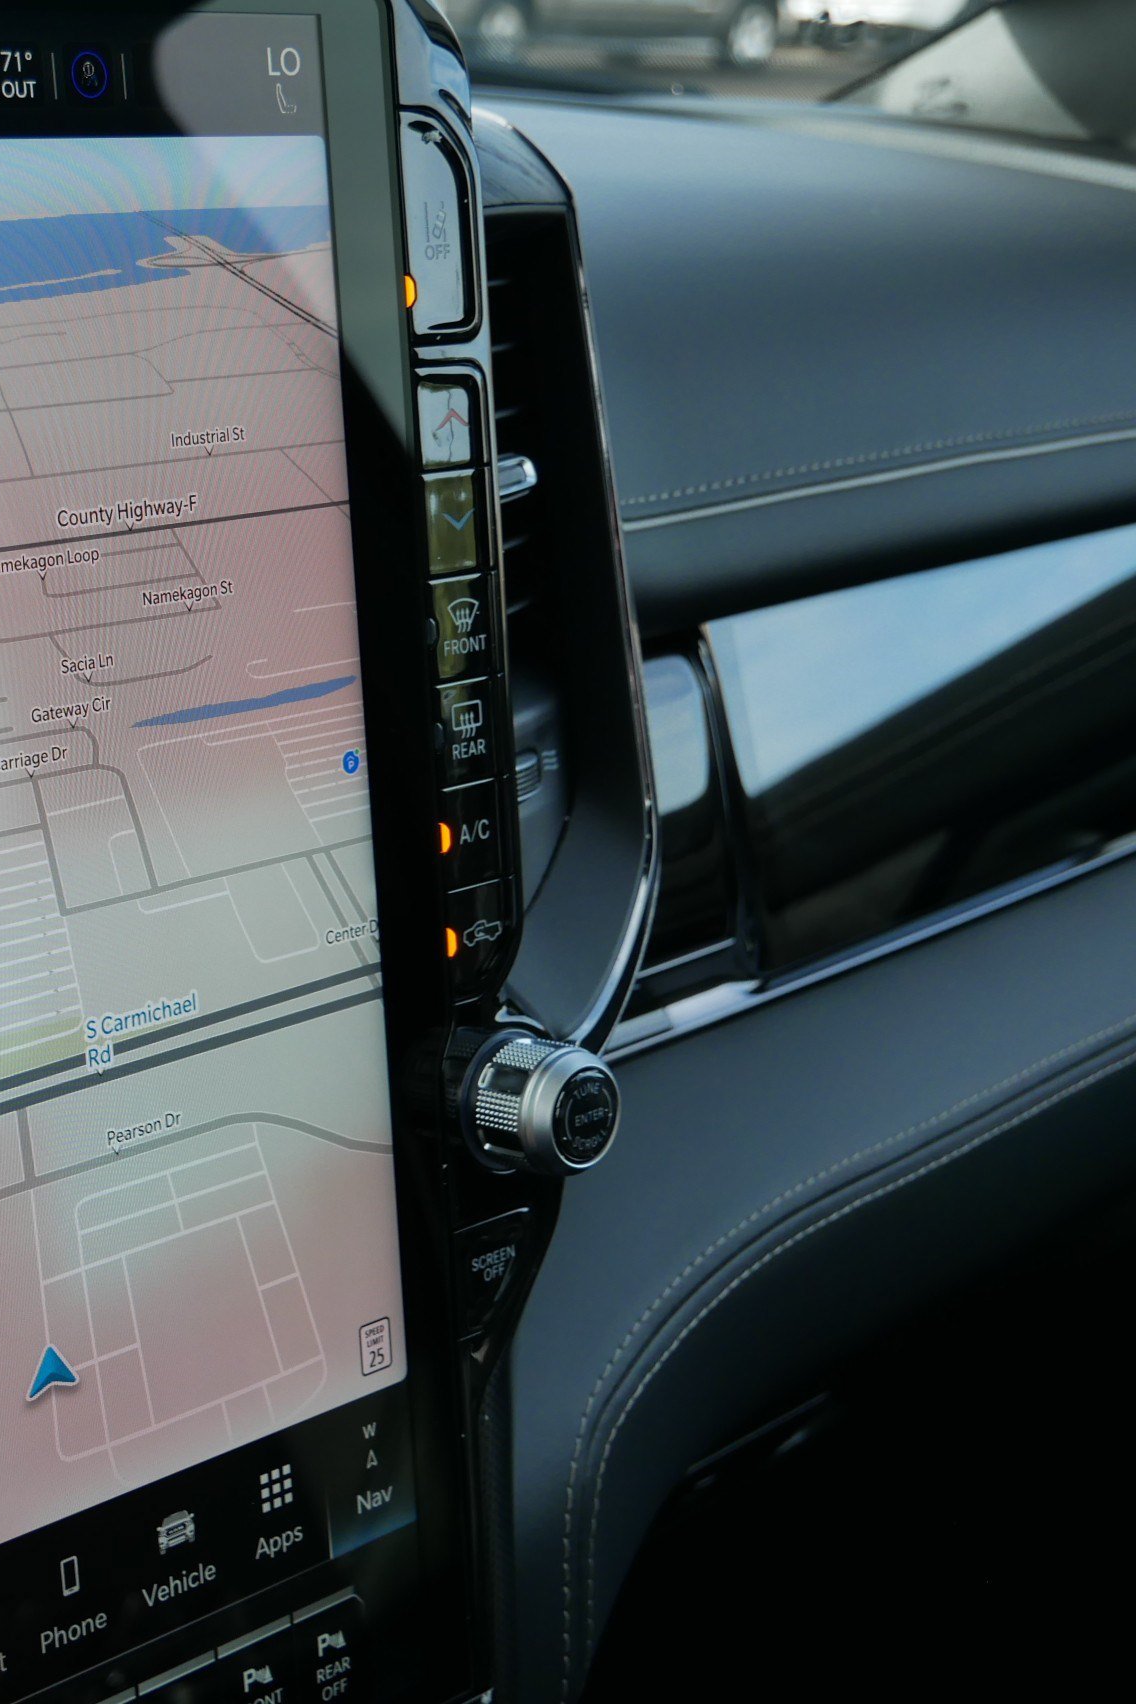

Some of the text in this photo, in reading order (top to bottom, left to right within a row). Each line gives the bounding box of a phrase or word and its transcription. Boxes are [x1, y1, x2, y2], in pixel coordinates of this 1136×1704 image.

[0, 51, 33, 73] 71°
[267, 47, 301, 76] LO
[2, 81, 36, 98] OUT
[425, 243, 450, 260] OFF
[171, 427, 245, 448] Industrial St
[57, 495, 197, 528] County Highway-F
[67, 549, 100, 565] Loop
[142, 581, 233, 606] Namekagon St
[443, 634, 487, 657] FRONT
[61, 654, 114, 674] Sacia Ln
[31, 697, 111, 723] Gateway Cir
[51, 747, 67, 761] Dr
[452, 739, 486, 760] REAR
[460, 819, 490, 845] A/C
[326, 919, 378, 945] Center D
[86, 993, 196, 1039] S Carmichael
[88, 1045, 112, 1067] Rd
[573, 1082, 601, 1100] TUNE
[574, 1107, 604, 1127] ENTER
[107, 1112, 181, 1146] Pearson Dr
[471, 1245, 516, 1272] SCREEN
[484, 1263, 505, 1282] OFF
[365, 1324, 385, 1338] SPEED
[367, 1335, 384, 1347] LIMIT
[369, 1348, 385, 1368] 25
[362, 1422, 377, 1439] W
[356, 1486, 393, 1514] Nav
[255, 1525, 304, 1560] Apps
[142, 1563, 216, 1607] Vehicle
[40, 1612, 108, 1654] Phone
[316, 1657, 351, 1684] REAR
[322, 1678, 348, 1702] OFF
